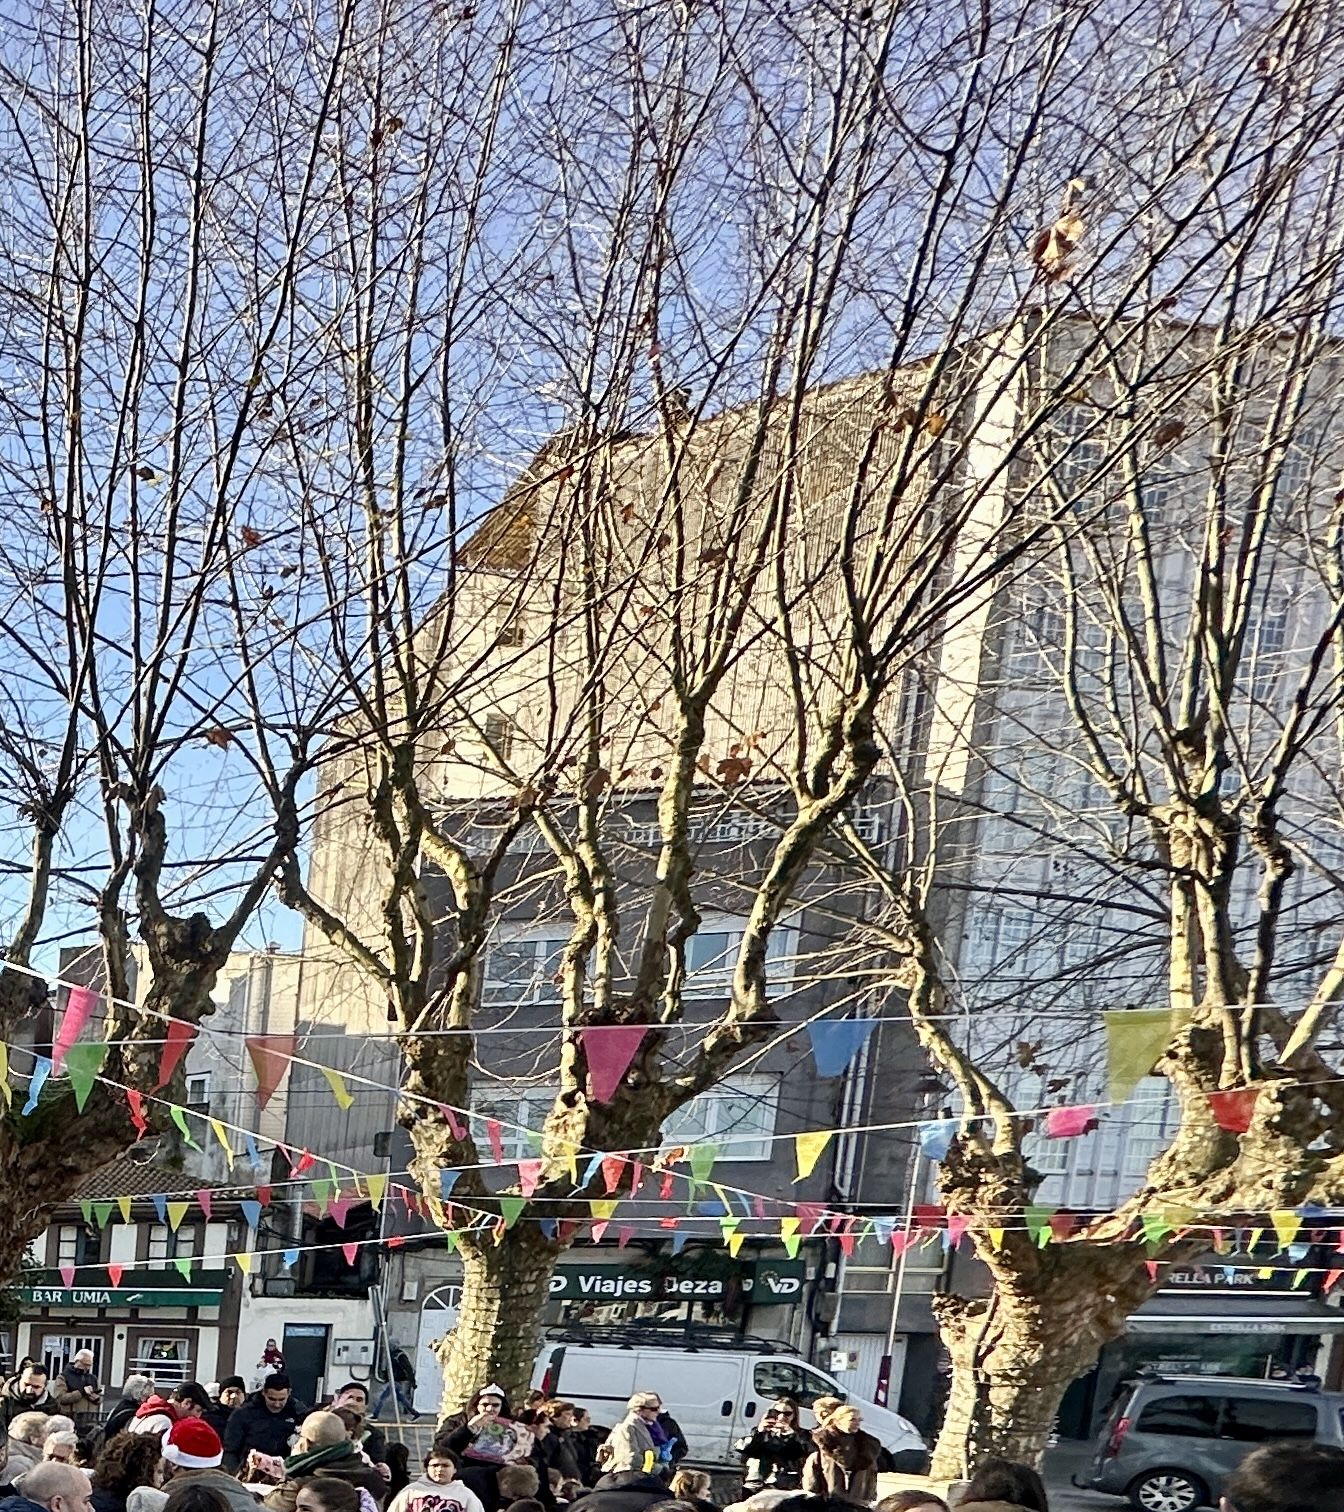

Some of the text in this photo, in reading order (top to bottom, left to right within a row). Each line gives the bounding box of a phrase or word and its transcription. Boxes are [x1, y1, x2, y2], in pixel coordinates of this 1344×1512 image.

[767, 1277, 800, 1293] VD
[1168, 1272, 1254, 1284] RELLA PARK
[548, 1275, 568, 1292] D
[578, 1275, 652, 1296] Viajes
[664, 1276, 723, 1293] Deza
[32, 1290, 112, 1303] BAR UMIA
